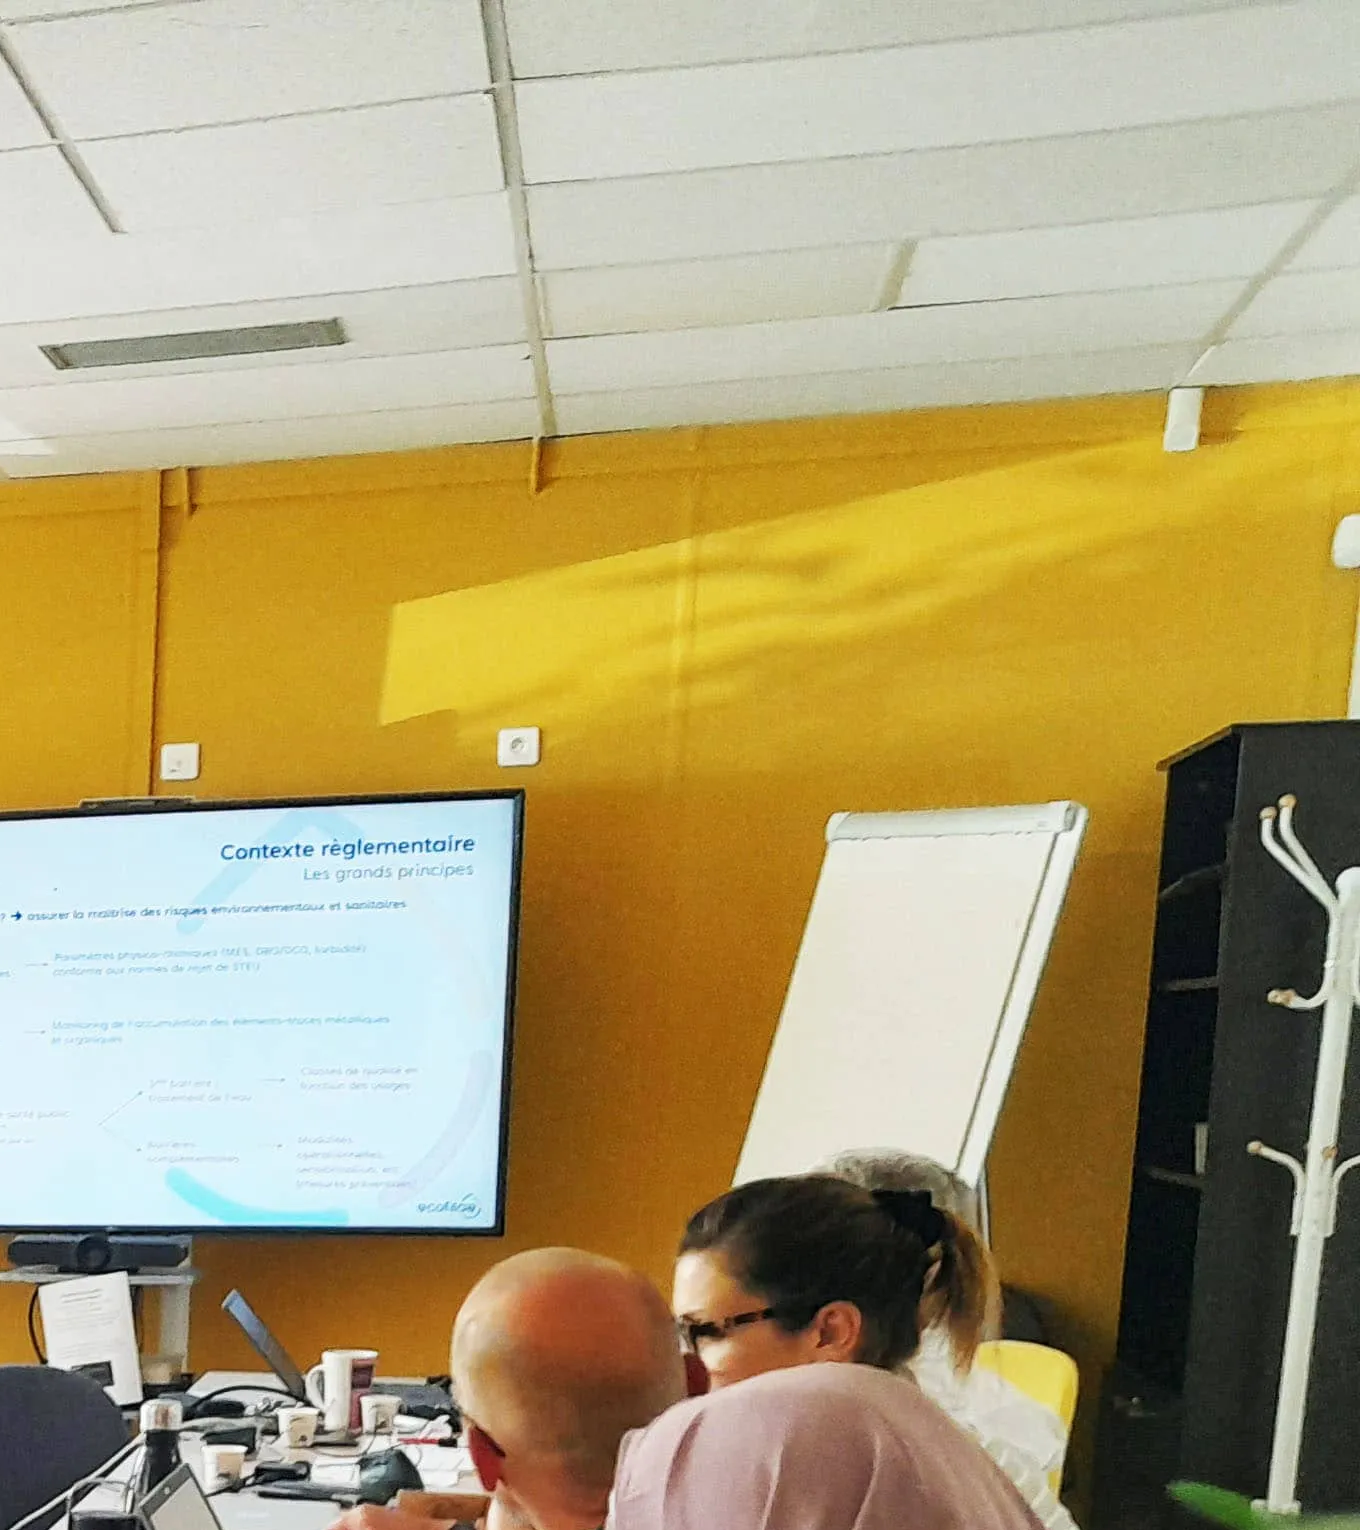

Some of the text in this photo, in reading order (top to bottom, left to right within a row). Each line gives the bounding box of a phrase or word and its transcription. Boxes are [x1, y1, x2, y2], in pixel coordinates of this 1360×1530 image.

[220, 843, 315, 861] Contexte
[303, 862, 475, 883] Les grands principes
[140, 905, 162, 917] des
[164, 905, 208, 919] risques
